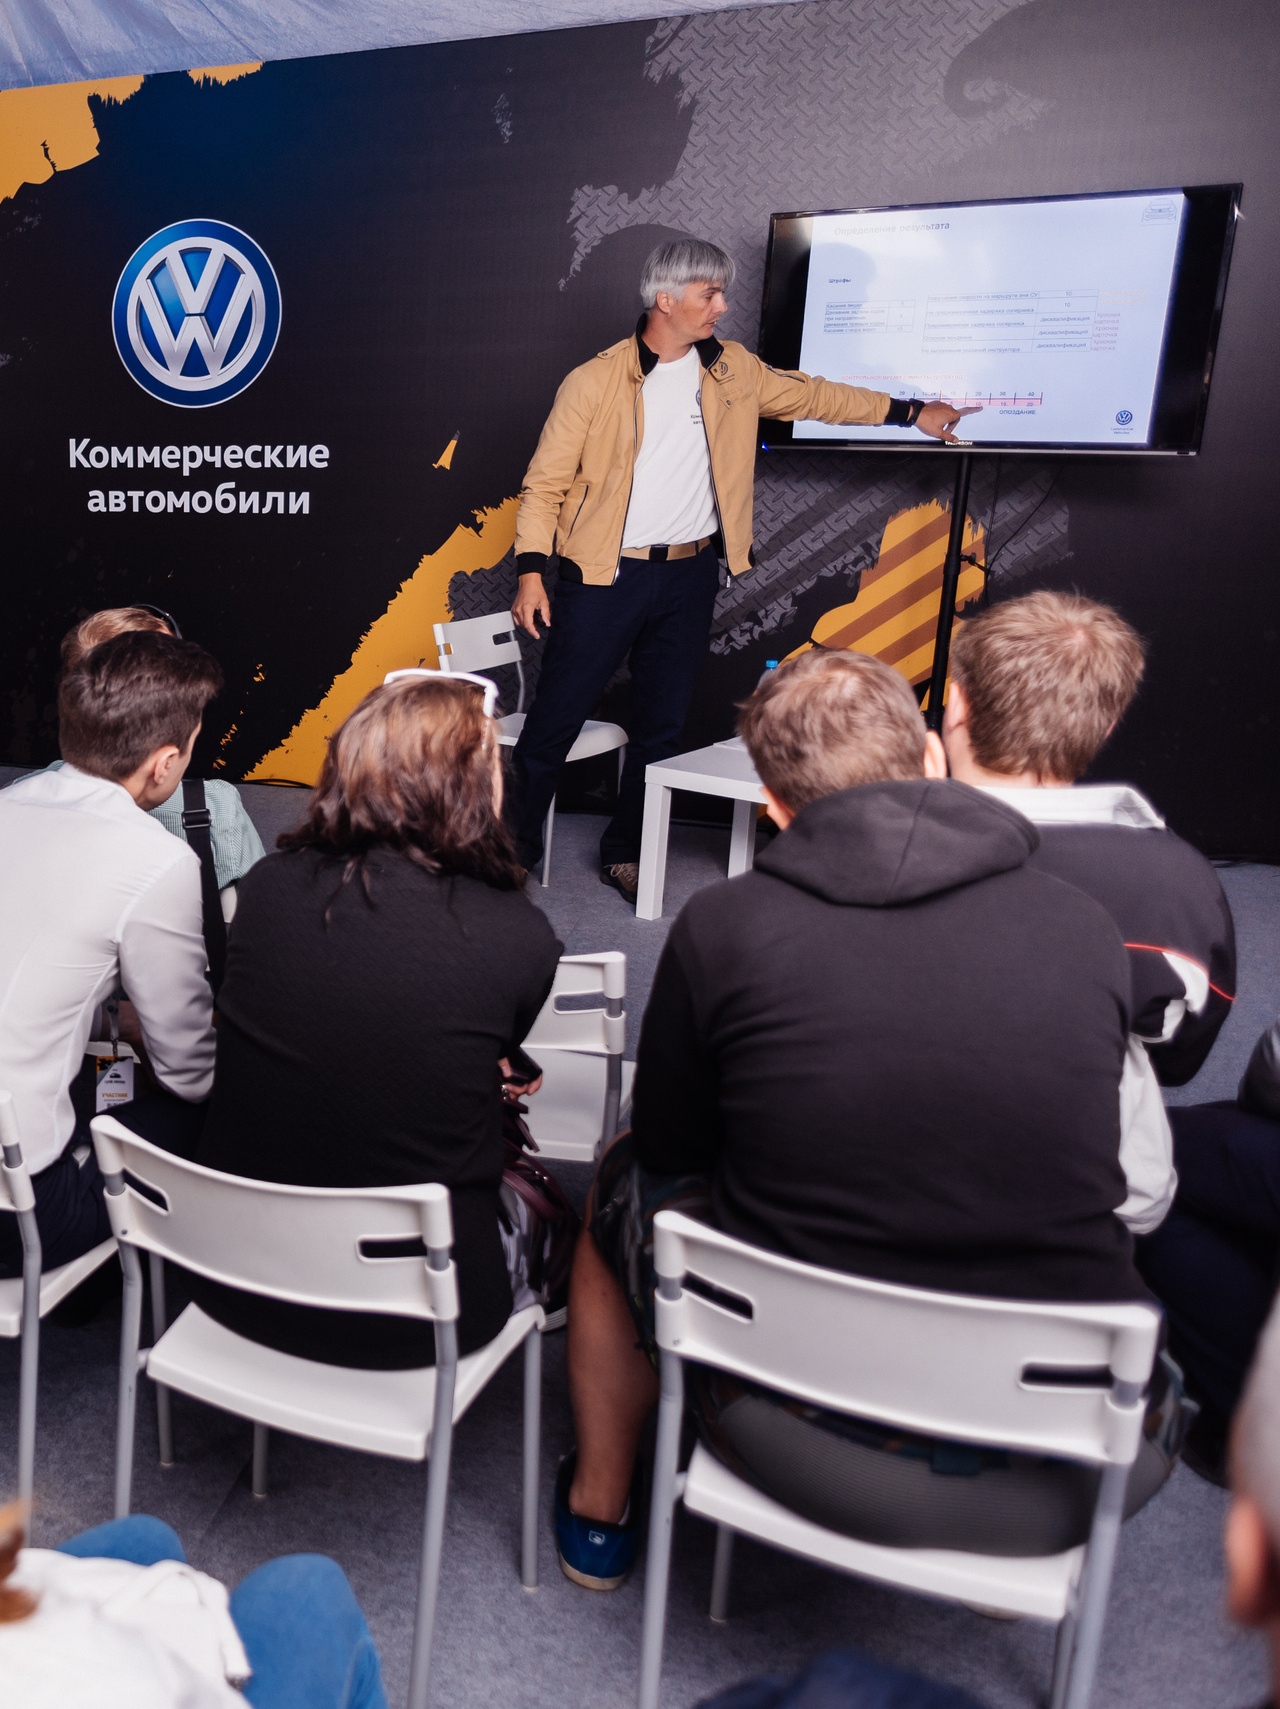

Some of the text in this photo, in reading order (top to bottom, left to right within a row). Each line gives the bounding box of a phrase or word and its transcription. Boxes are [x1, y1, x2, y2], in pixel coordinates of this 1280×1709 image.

[899, 221, 951, 233] результата
[68, 437, 330, 476] Коммерческие
[87, 481, 311, 515] автомобили
